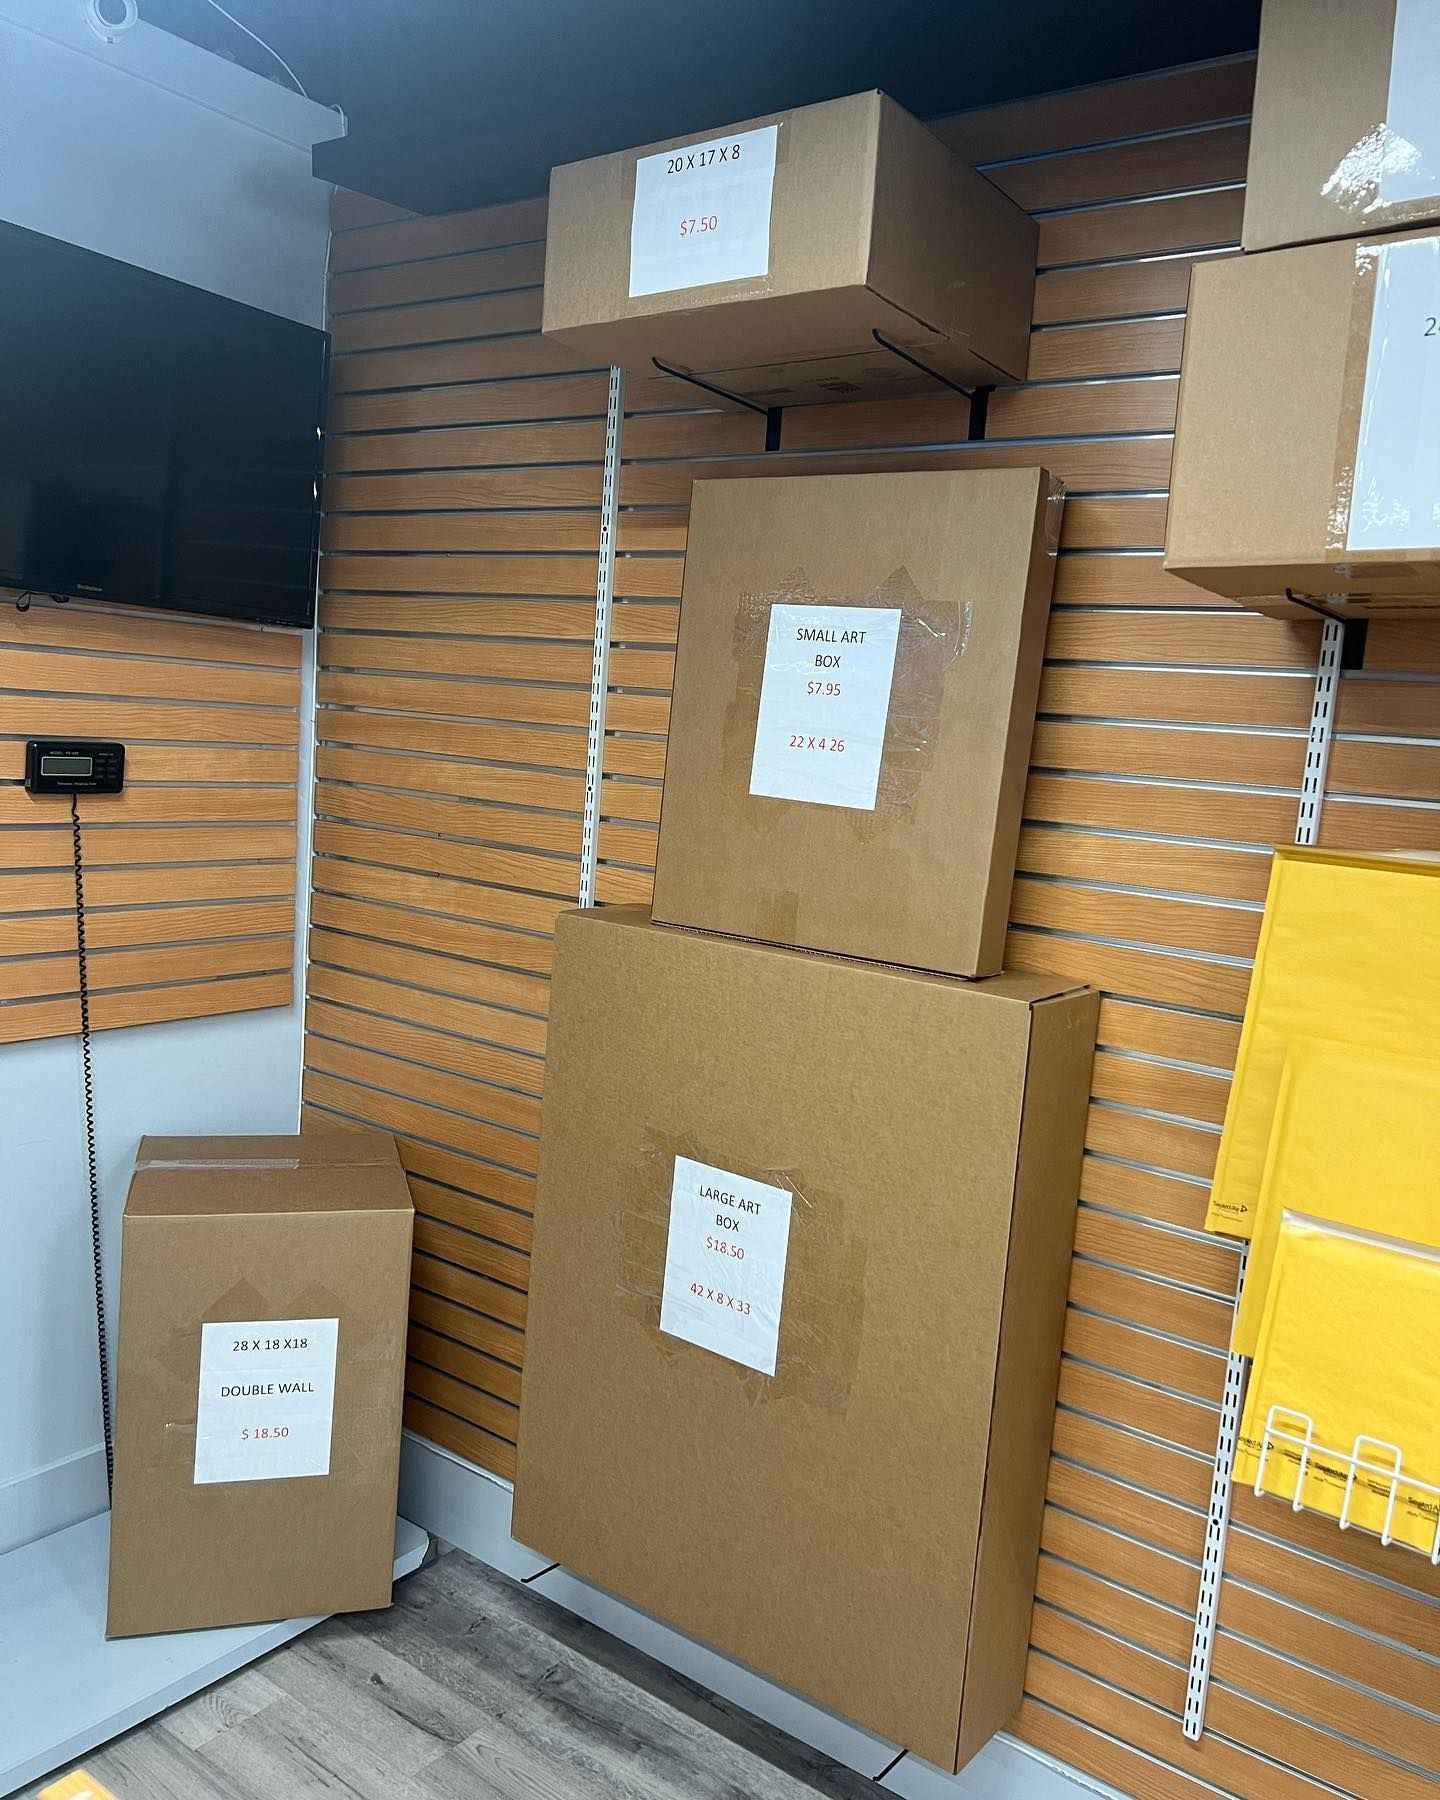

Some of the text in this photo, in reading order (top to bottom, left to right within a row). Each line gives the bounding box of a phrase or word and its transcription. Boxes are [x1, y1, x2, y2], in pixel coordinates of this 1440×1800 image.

[667, 144, 740, 174] 20 X 17 X 8
[680, 215, 718, 238] $7.50
[1424, 317, 1440, 336] 2
[796, 628, 867, 645] SMALL ART
[814, 654, 841, 668] BOX
[807, 681, 841, 696] $7.95
[789, 735, 845, 753] 22 X 4 26
[699, 1185, 762, 1216] LARGE ART
[716, 1214, 740, 1233] BOX
[706, 1236, 745, 1260] $18.50
[690, 1283, 751, 1315] 42 X 8 X 33
[233, 1338, 308, 1352] 28 X 18 X18
[221, 1382, 315, 1397] DOUBLE WALL
[242, 1427, 289, 1440] $ 18.50
